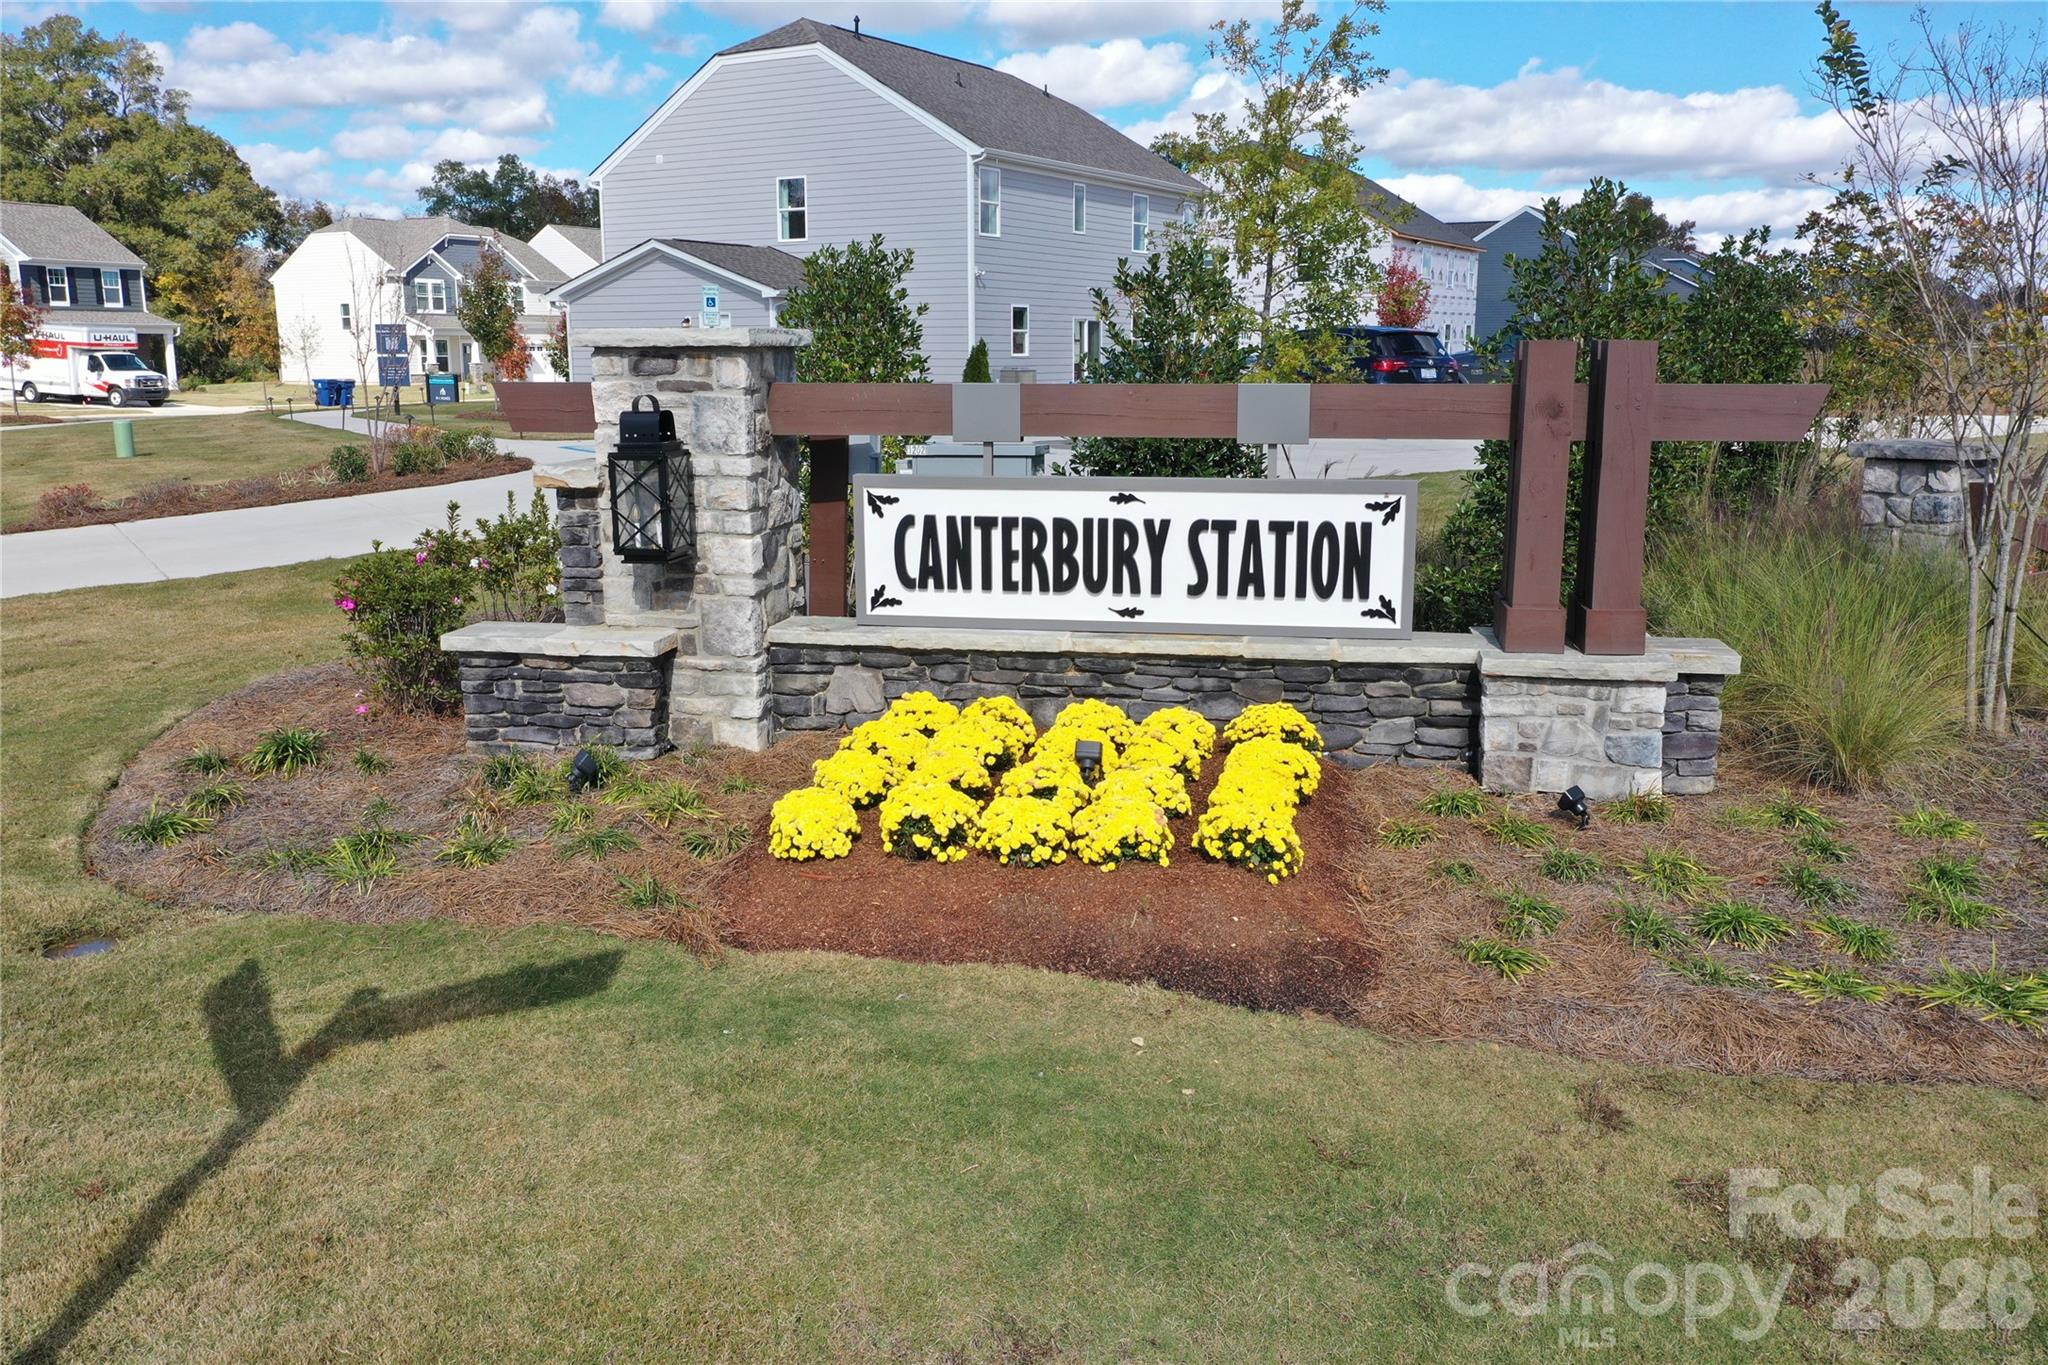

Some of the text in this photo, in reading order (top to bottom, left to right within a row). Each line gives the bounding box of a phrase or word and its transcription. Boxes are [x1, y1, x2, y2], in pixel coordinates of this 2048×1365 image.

[93, 333, 132, 342] U-HAUL
[894, 514, 1373, 601] CANTERBURY STATION
